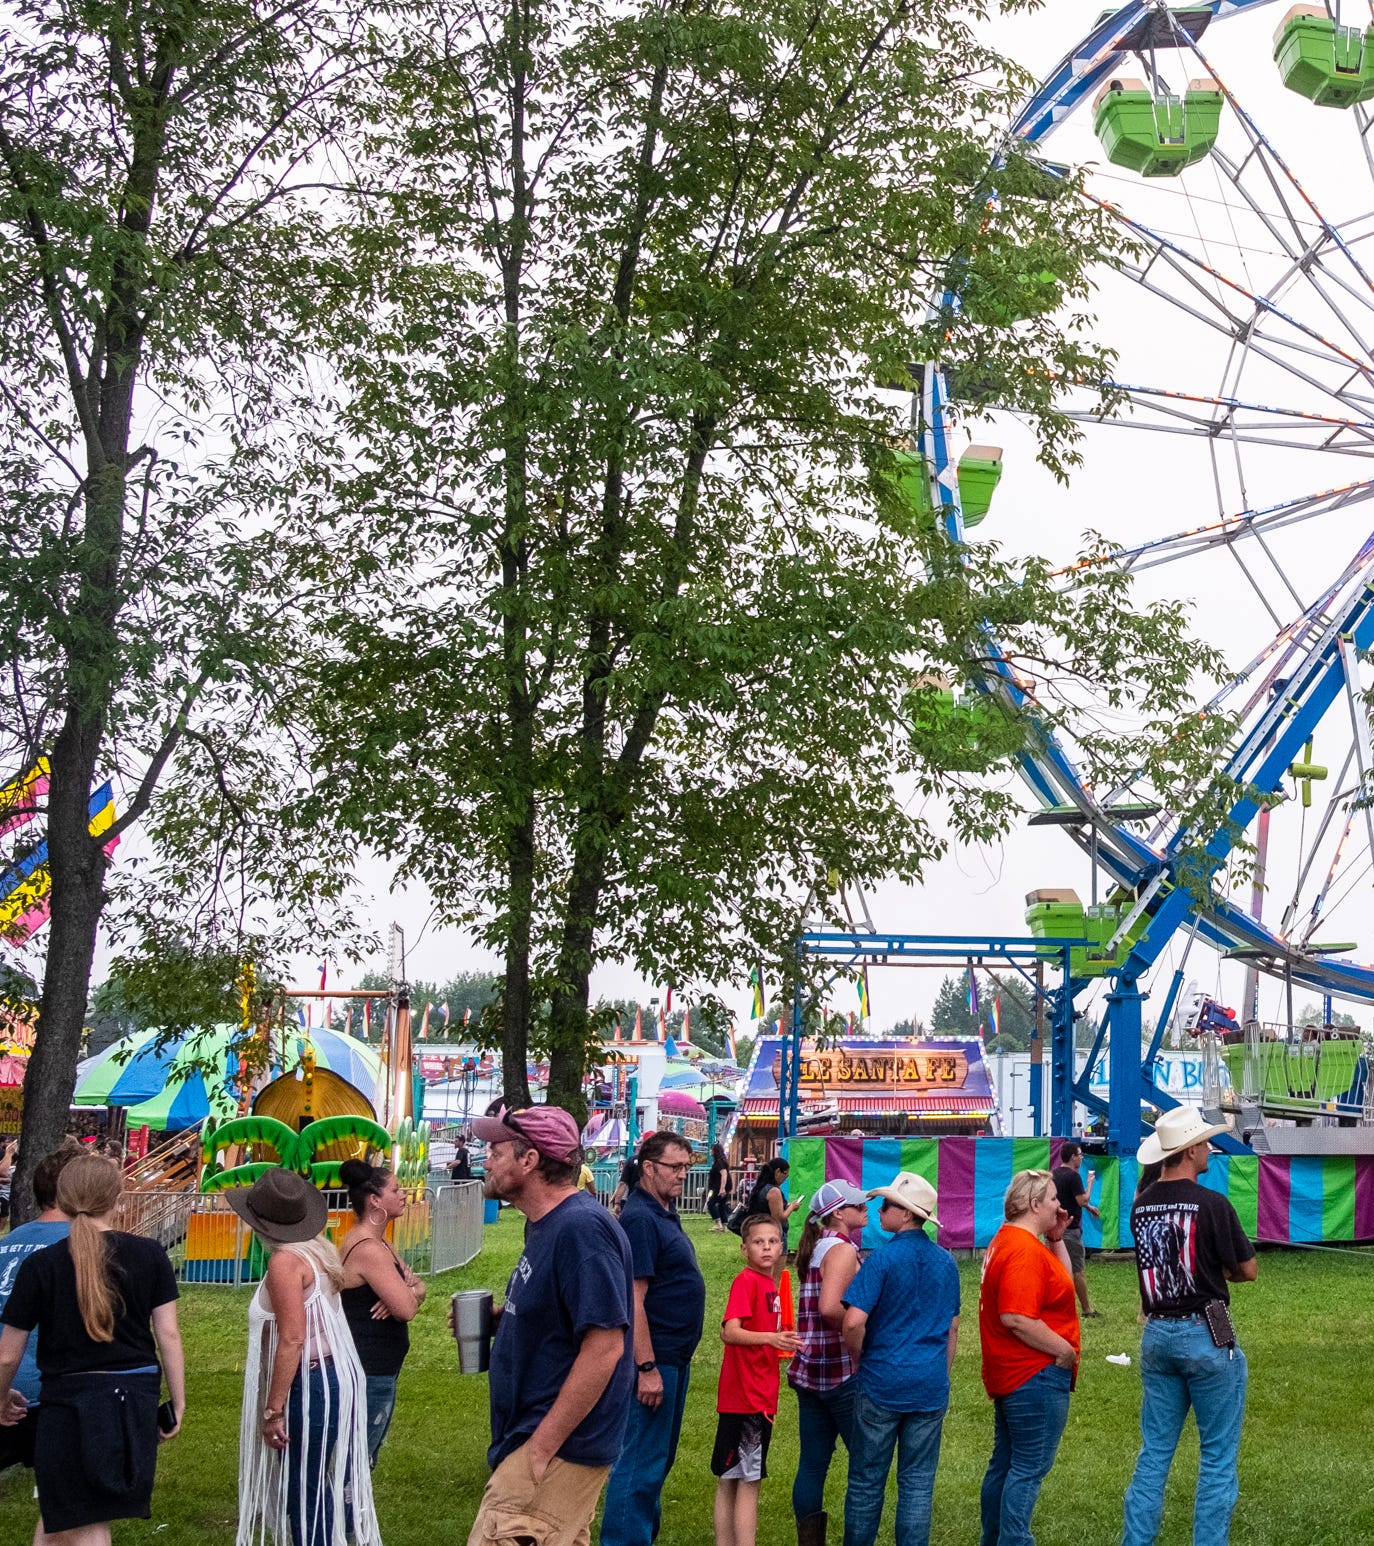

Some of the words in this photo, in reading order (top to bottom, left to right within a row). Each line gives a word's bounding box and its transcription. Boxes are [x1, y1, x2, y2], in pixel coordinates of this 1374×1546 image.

[836, 1057, 920, 1082] SANTA
[926, 1057, 957, 1081] FE
[1145, 1204, 1167, 1213] WHITE
